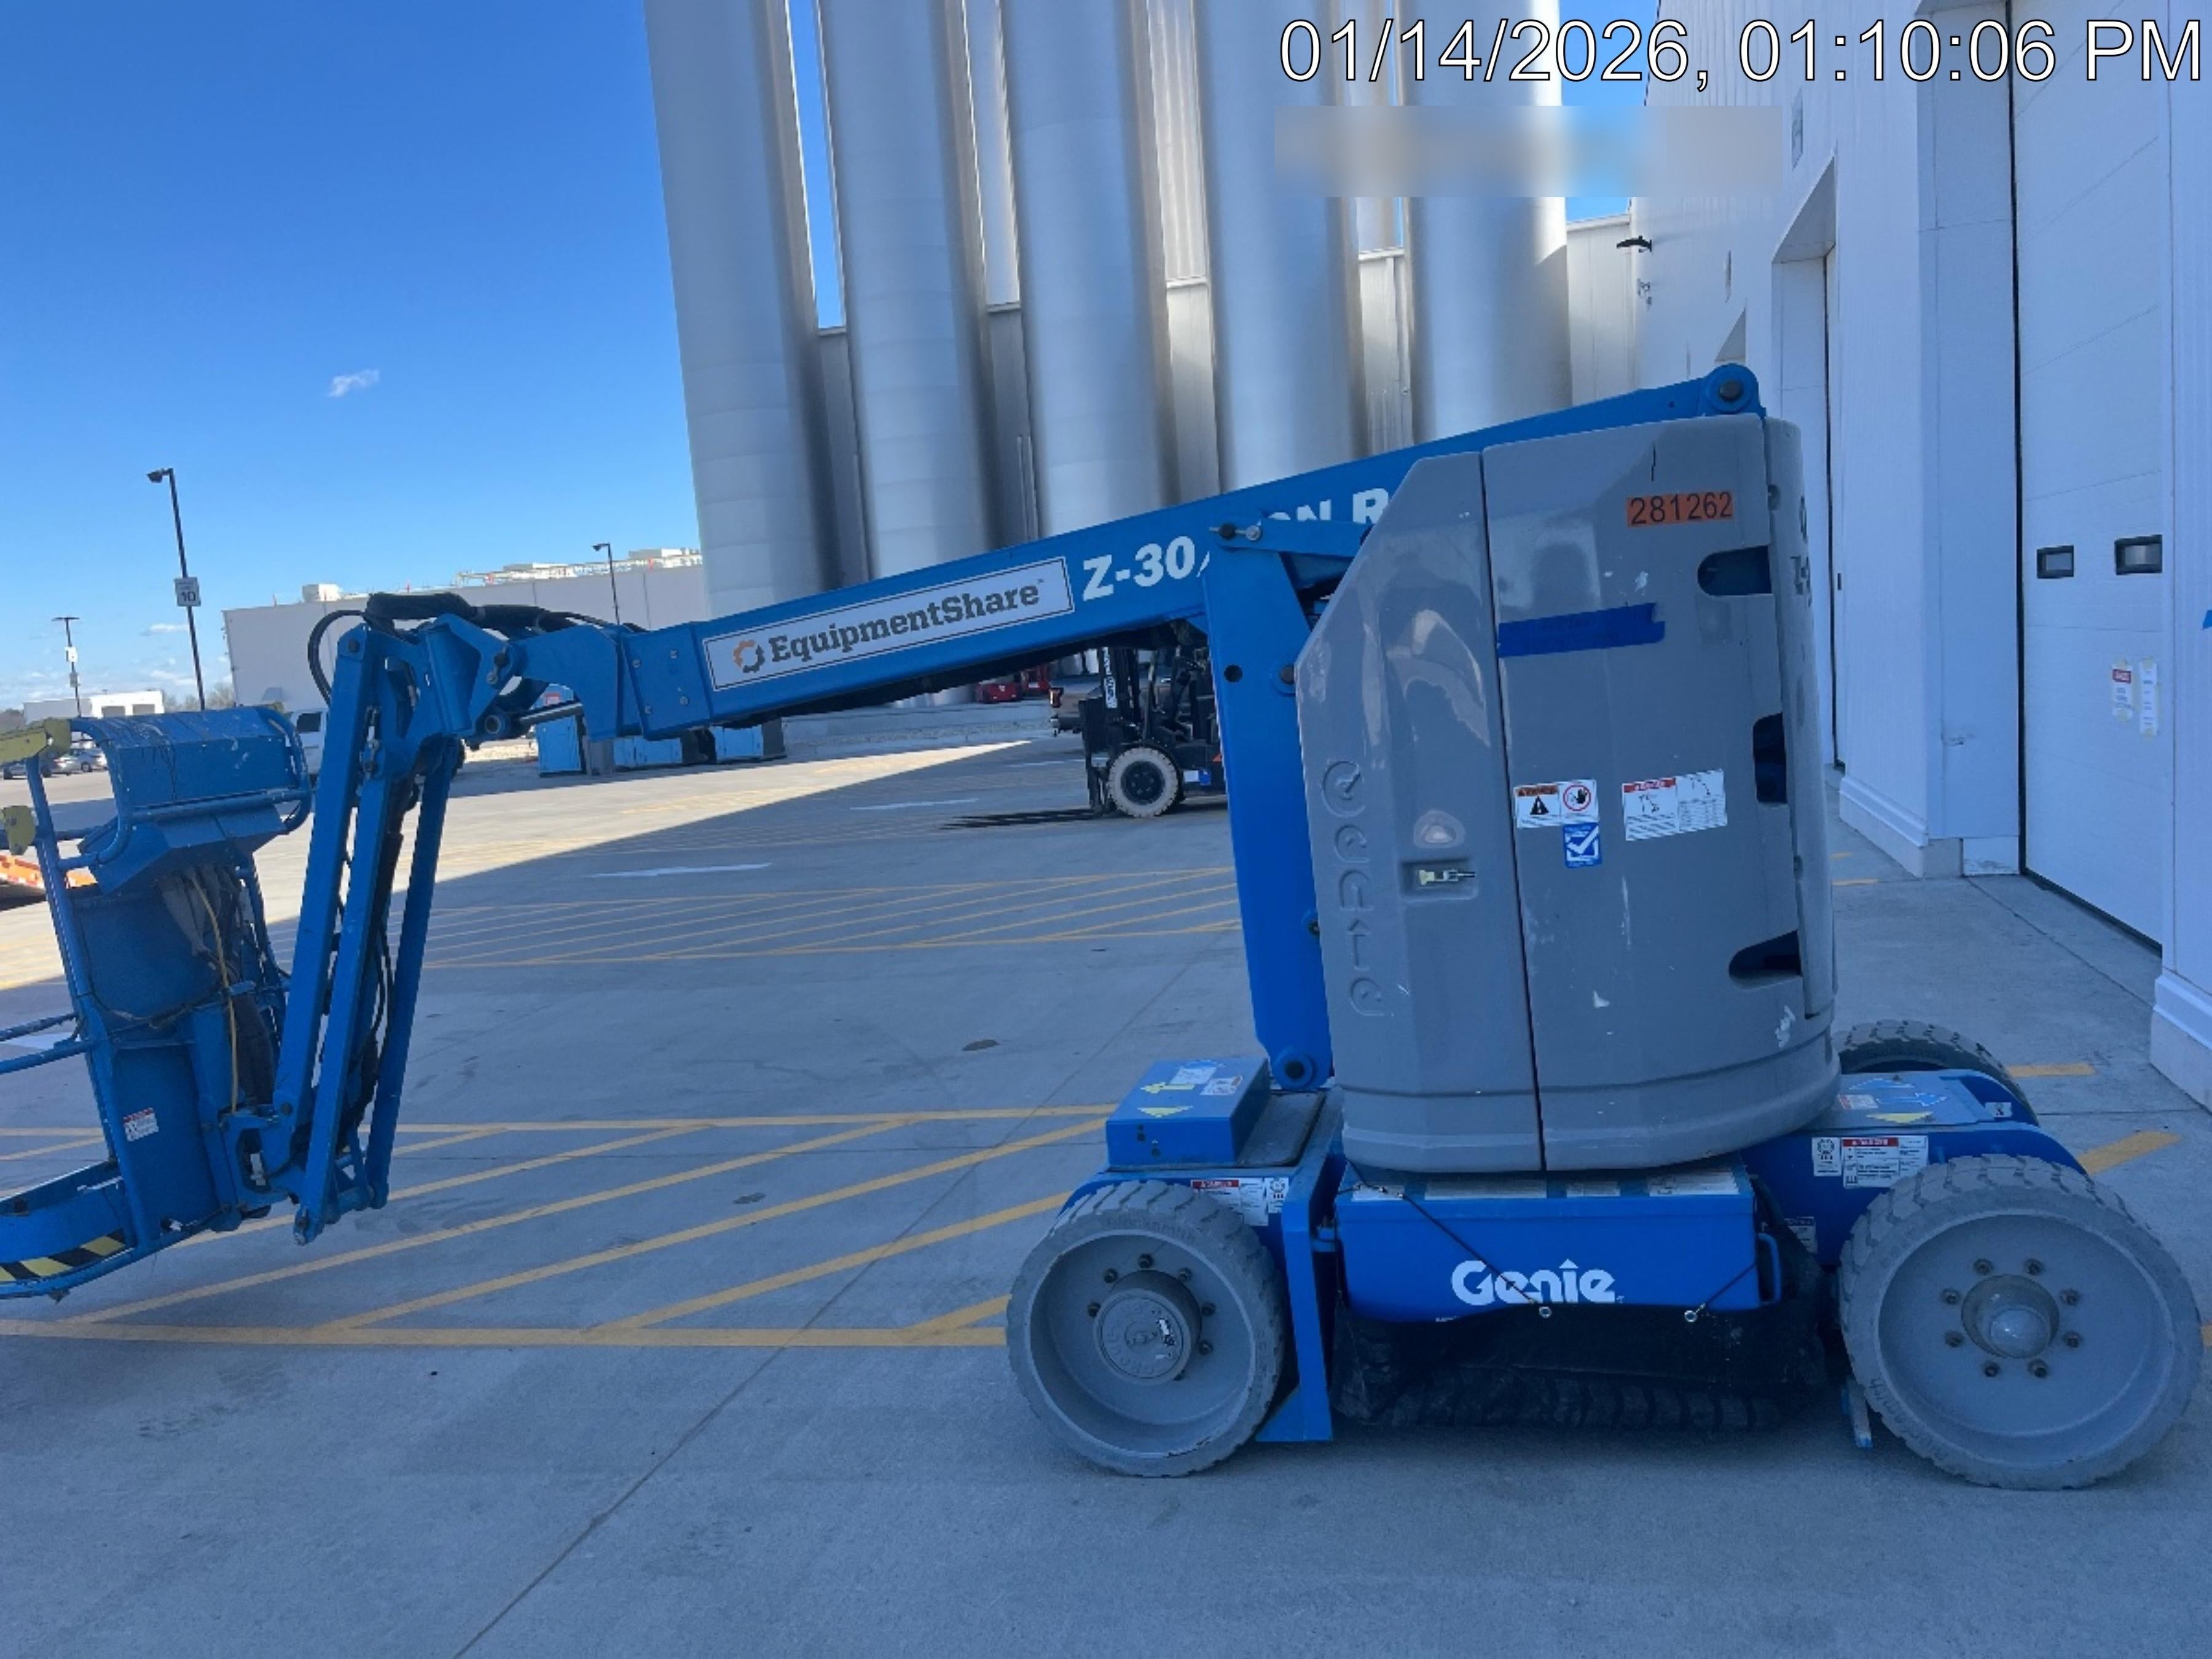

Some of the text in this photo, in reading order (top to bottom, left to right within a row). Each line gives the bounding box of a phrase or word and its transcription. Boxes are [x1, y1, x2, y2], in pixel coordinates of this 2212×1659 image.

[1631, 492, 1732, 524] 281262
[769, 584, 1039, 662] EquipmentShare
[1451, 1259, 1615, 1305] Genie
